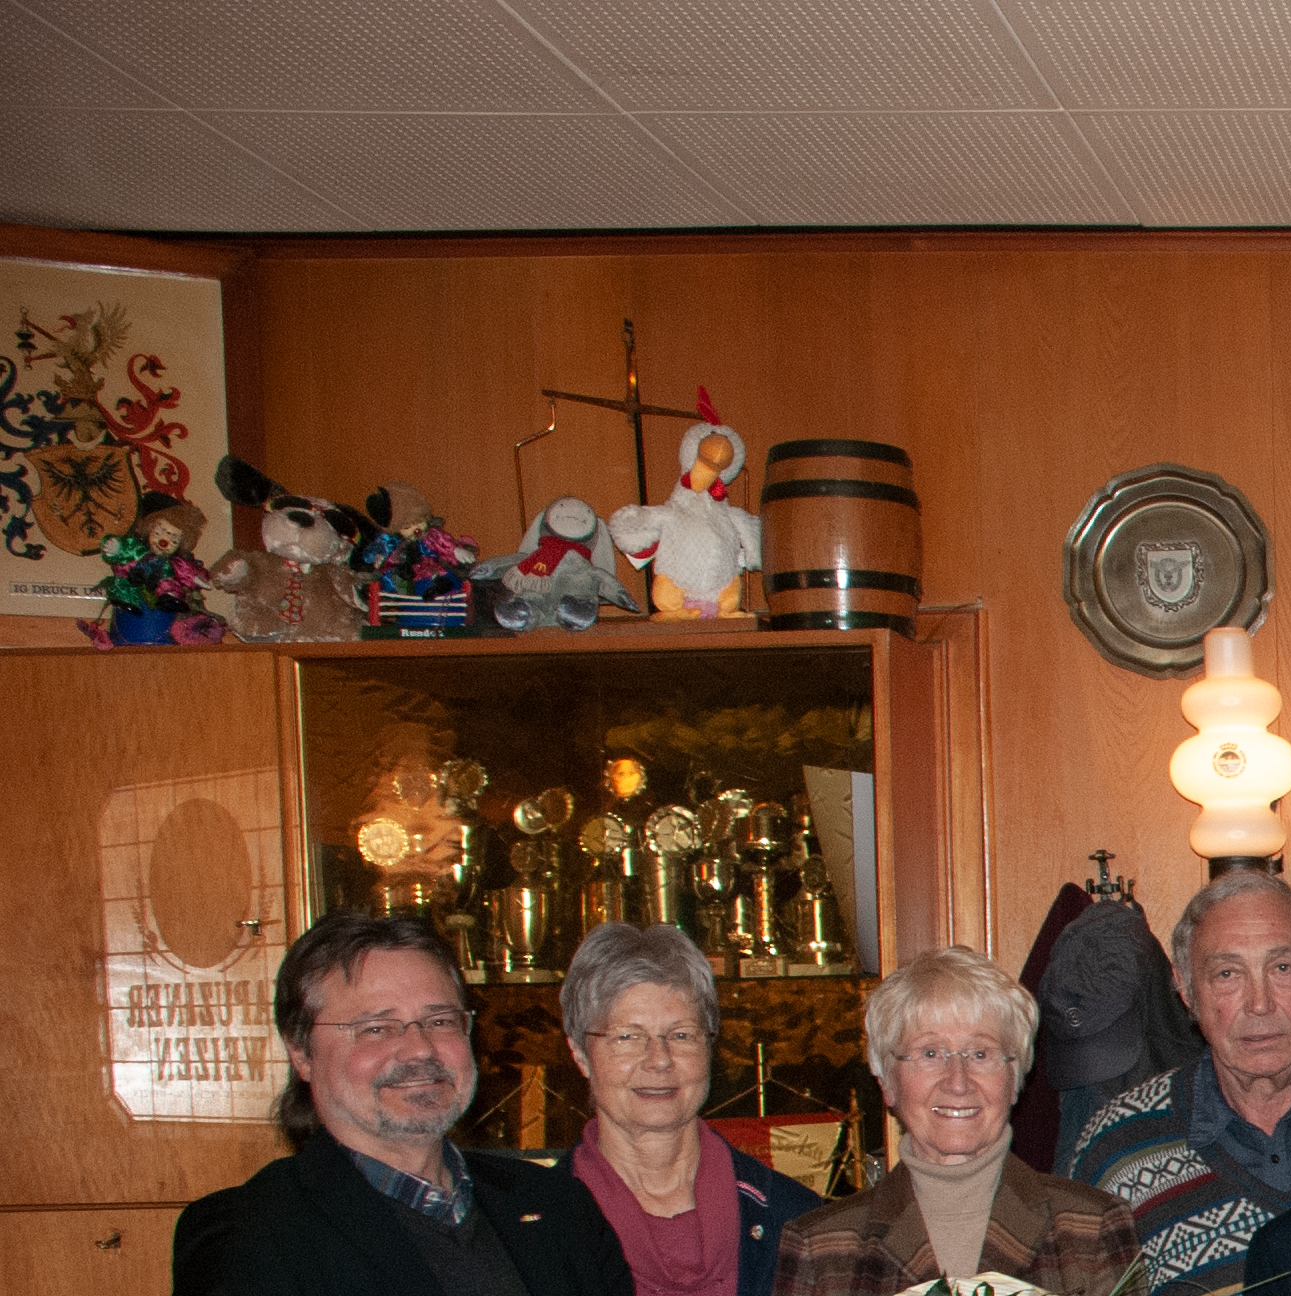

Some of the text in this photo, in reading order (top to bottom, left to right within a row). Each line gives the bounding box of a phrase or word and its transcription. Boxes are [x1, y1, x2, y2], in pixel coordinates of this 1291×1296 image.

[14, 585, 103, 596] IG DRUCK UN
